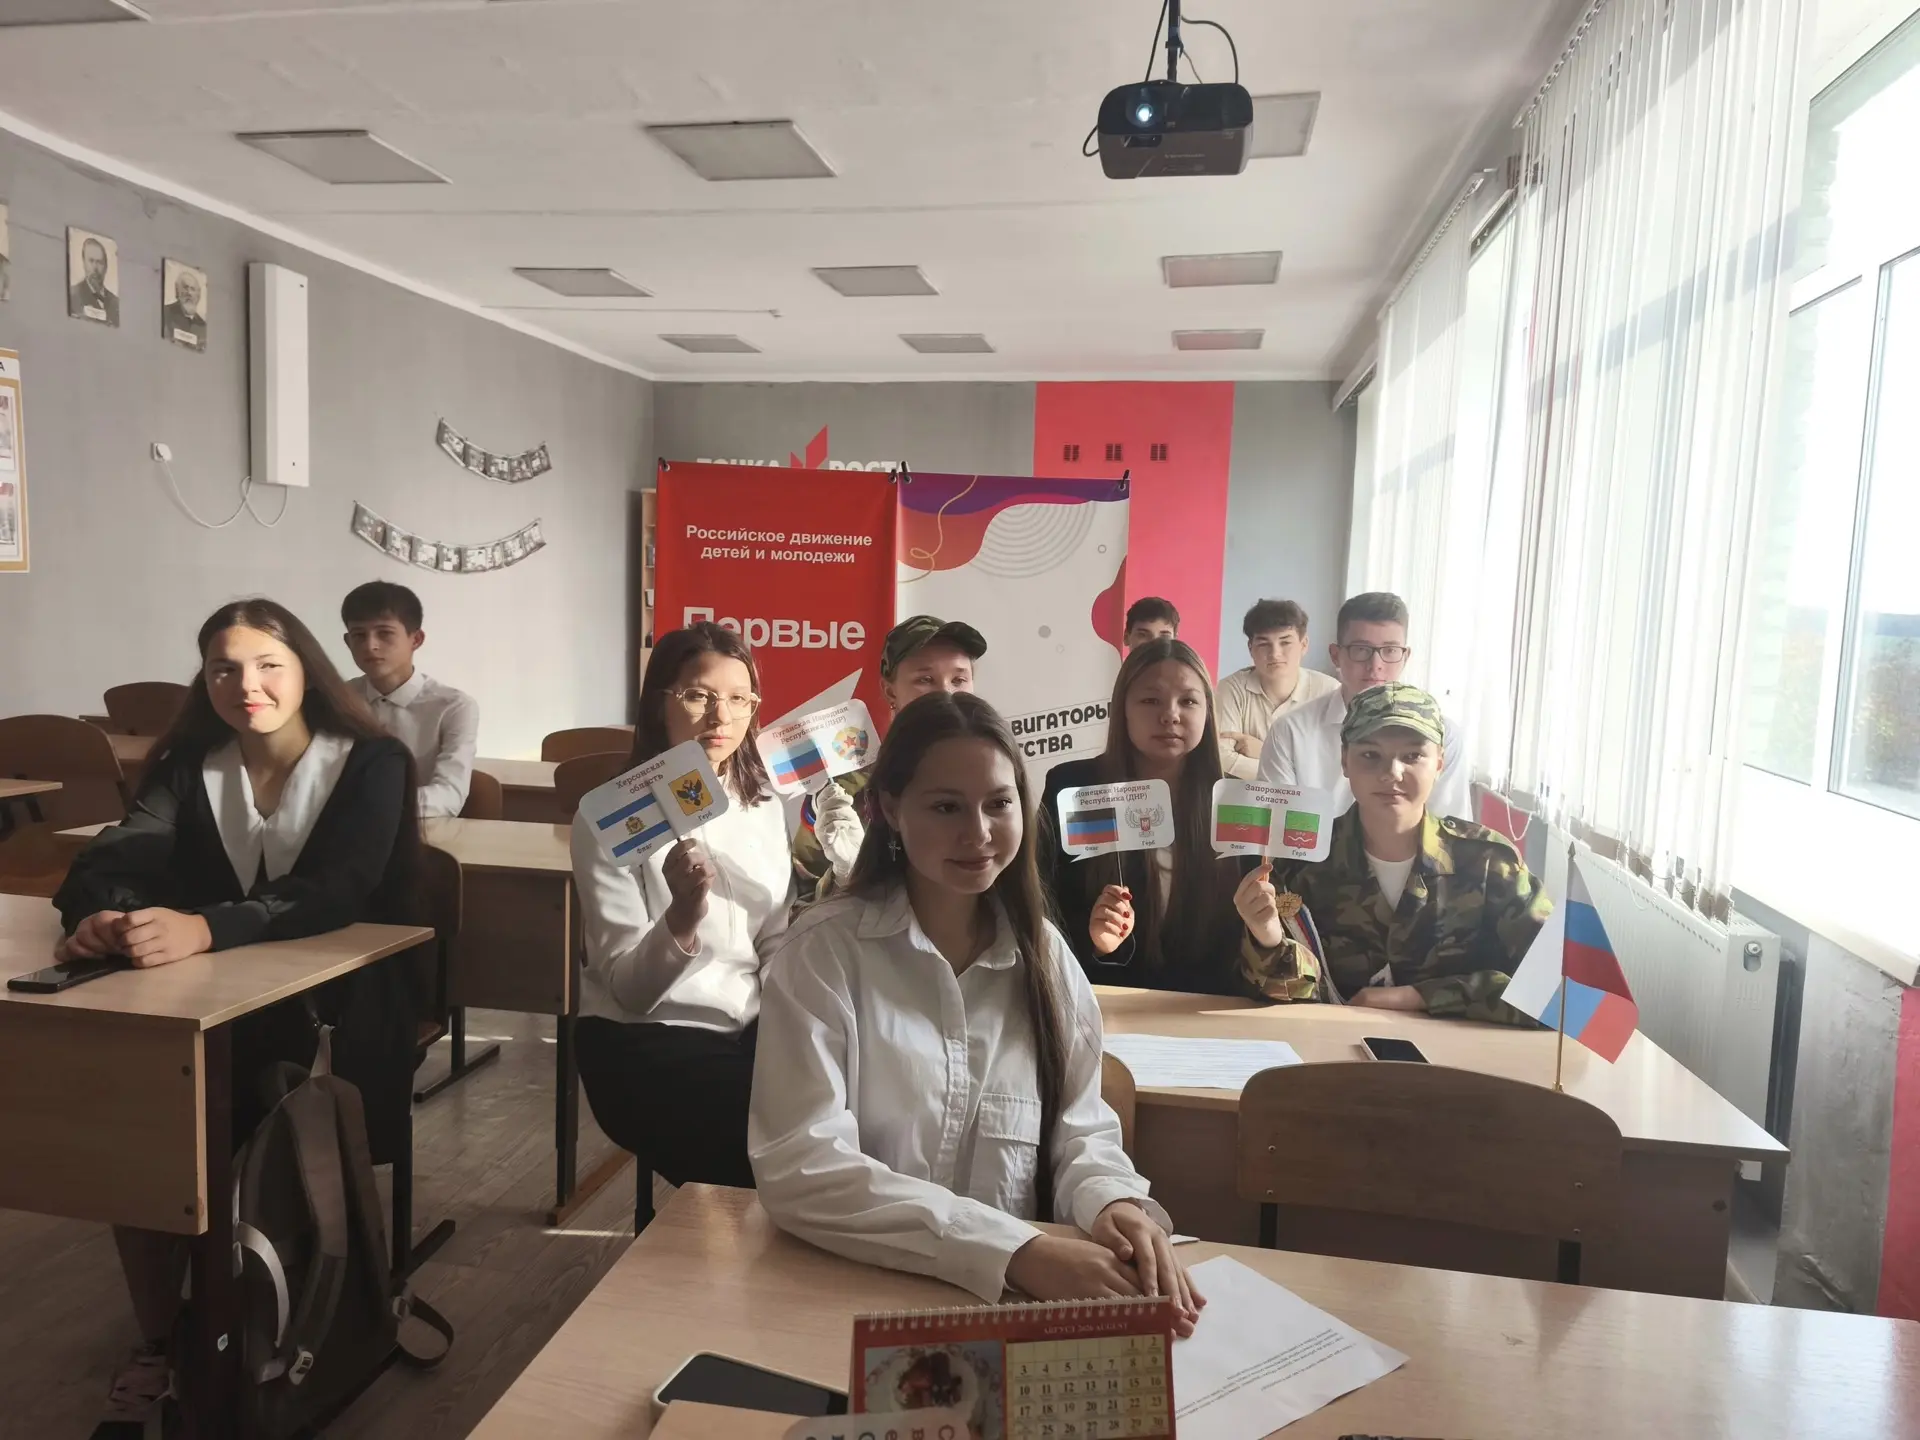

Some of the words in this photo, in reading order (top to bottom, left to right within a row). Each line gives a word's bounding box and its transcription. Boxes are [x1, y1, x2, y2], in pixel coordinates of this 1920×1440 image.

[686, 524, 785, 543] Российское
[789, 532, 872, 546] движение
[701, 545, 750, 560] детей
[755, 550, 765, 560] и
[771, 550, 855, 564] молодежи
[1018, 733, 1073, 757] СТВА
[615, 759, 666, 789] Херсонская
[629, 774, 664, 794] область
[1245, 783, 1302, 797] Запорожская
[1255, 795, 1289, 805] область
[1131, 1339, 1134, 1347] 1
[1152, 1337, 1156, 1346] 2
[1021, 1365, 1026, 1375] 3
[1043, 1364, 1048, 1373] 4
[1065, 1363, 1071, 1371] 5
[1087, 1361, 1093, 1370] 6
[1109, 1359, 1114, 1369] 7
[1130, 1358, 1136, 1367] 8
[1152, 1357, 1157, 1365] 9
[1020, 1386, 1030, 1395] 10
[1042, 1384, 1050, 1394] 11
[1064, 1383, 1074, 1392] 12
[1086, 1381, 1096, 1390] 13
[1108, 1380, 1117, 1389] 14
[1129, 1378, 1139, 1387] 15
[1151, 1377, 1161, 1386] 16
[1020, 1406, 1030, 1416] 17
[1042, 1405, 1052, 1414] 18
[1065, 1403, 1074, 1412] 19
[1086, 1402, 1097, 1411] 20
[1108, 1400, 1117, 1409] 21
[1130, 1398, 1140, 1407] 22
[1152, 1397, 1161, 1406] 23
[1042, 1425, 1053, 1435] 25
[1065, 1424, 1075, 1433] 26
[1109, 1421, 1119, 1430] 28
